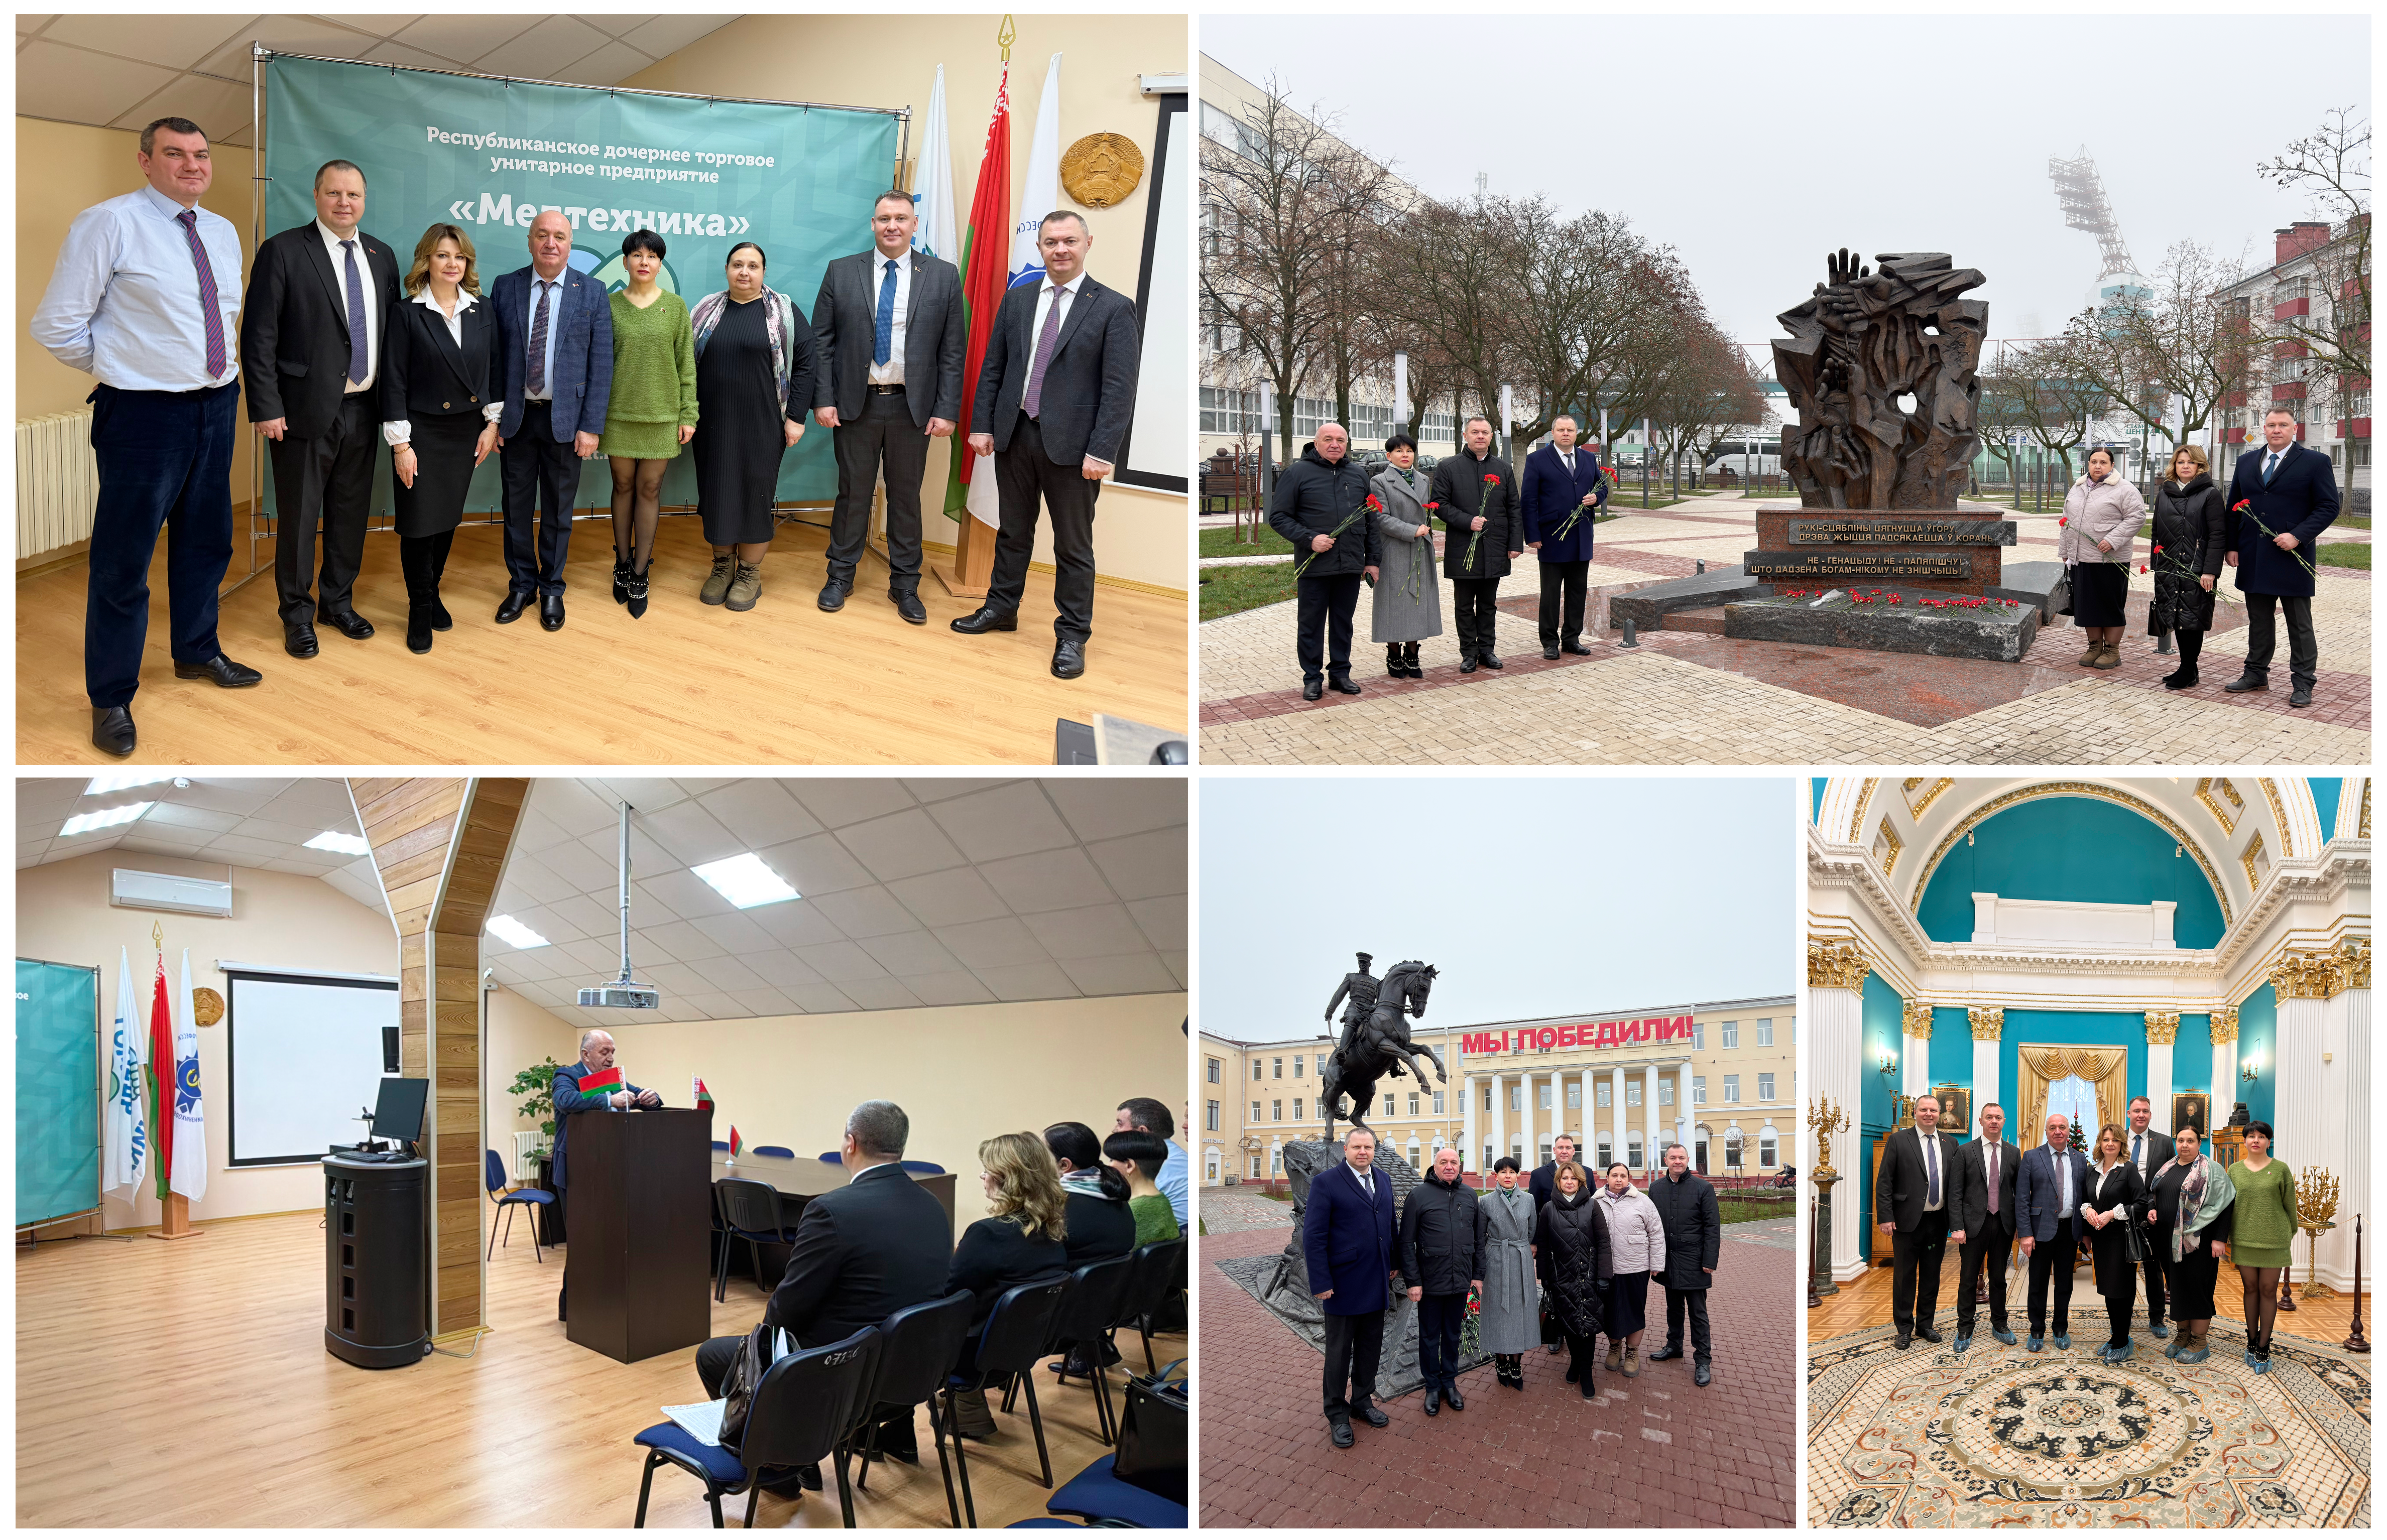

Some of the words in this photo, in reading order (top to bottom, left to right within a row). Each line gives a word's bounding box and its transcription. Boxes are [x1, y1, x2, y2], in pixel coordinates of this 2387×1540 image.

[427, 126, 600, 155] Республиканское
[604, 145, 690, 163] дочернее
[695, 152, 775, 168] торговое
[491, 157, 594, 176] унитарное
[600, 165, 719, 183] предприятие
[449, 192, 750, 236] «Метехника»
[1874, 534, 1944, 542] ПАДСЯКАЕЦЦА
[1948, 534, 1953, 542] Ў
[1927, 524, 1957, 534] ЎГОРУ,
[1907, 567, 1962, 575] ЗНІШЧЫЦЬ!
[1462, 1031, 1508, 1054] МЫ
[1517, 1015, 1694, 1050] ПОБЕДИЛИ!
